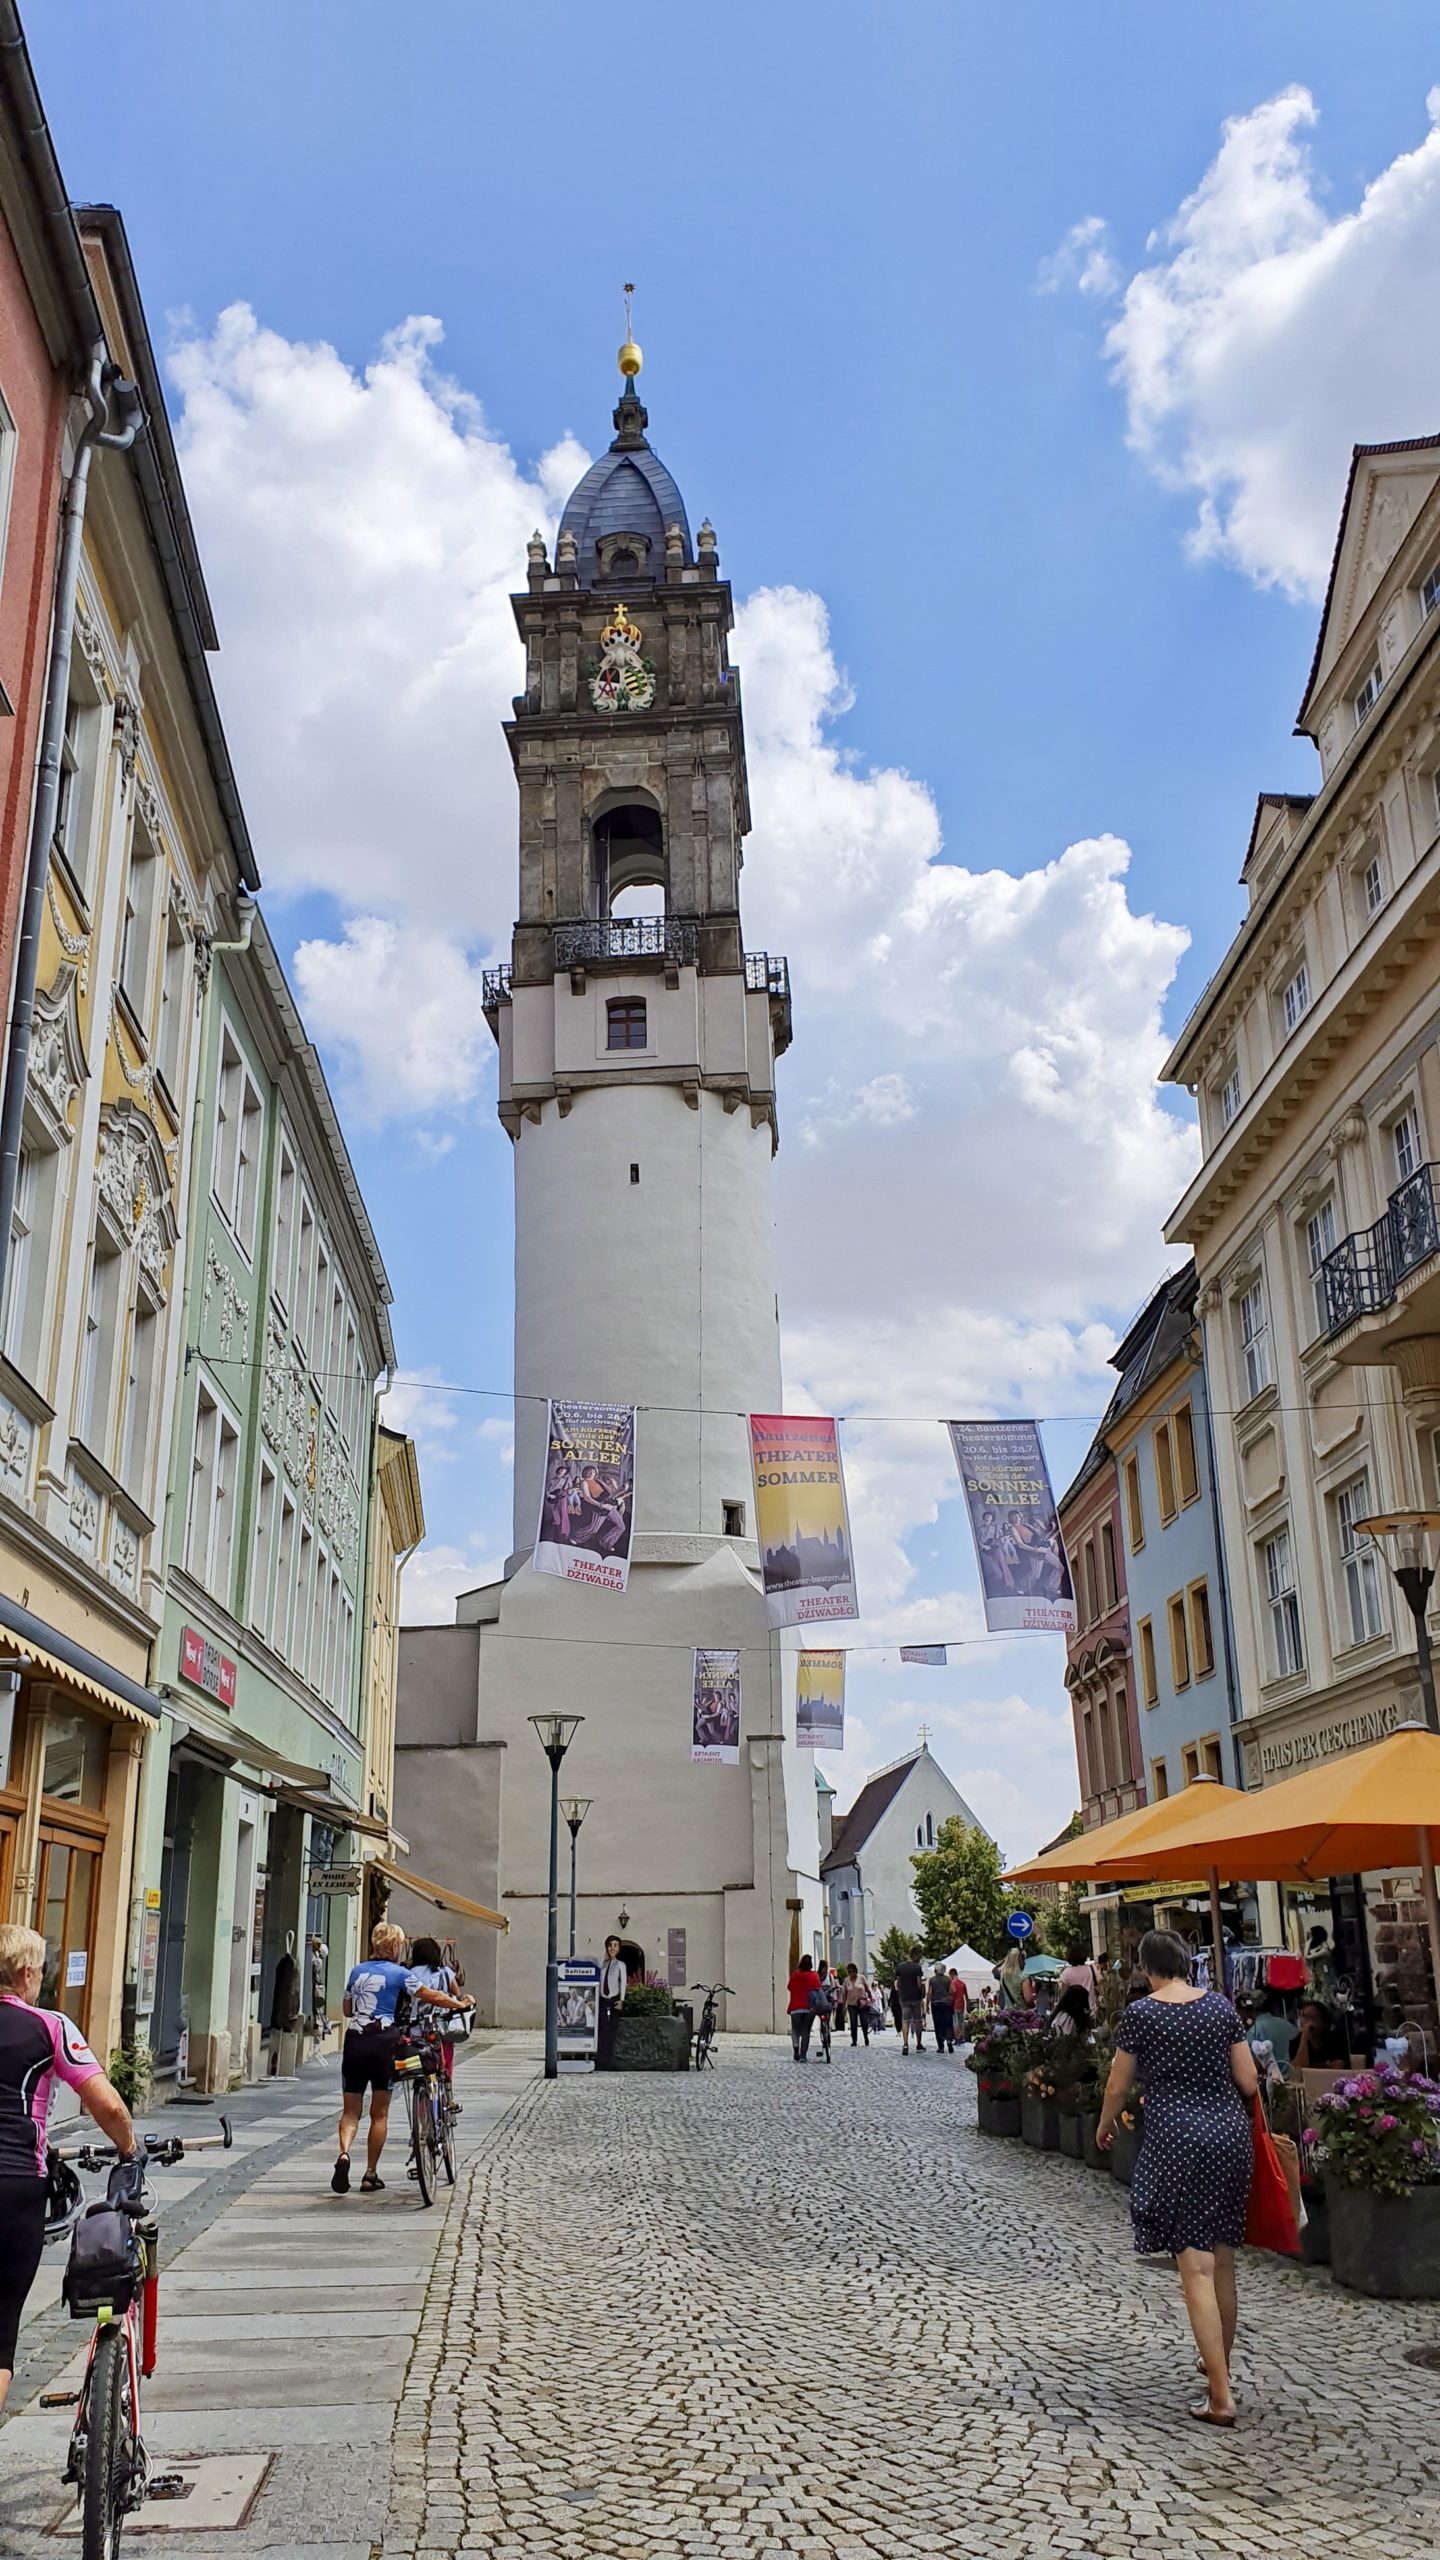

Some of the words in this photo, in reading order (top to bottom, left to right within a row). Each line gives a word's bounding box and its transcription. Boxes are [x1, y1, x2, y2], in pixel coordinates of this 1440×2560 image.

[977, 1424, 1030, 1432] Bautzener
[755, 1431, 833, 1443] Bautzener
[954, 1433, 1038, 1441] Theatersommer
[992, 1445, 1008, 1453] bis
[563, 1450, 621, 1465] ALLEE
[756, 1450, 838, 1464] THEATER
[757, 1472, 840, 1488] SOMMER
[967, 1480, 1050, 1492] SONNEN-
[985, 1493, 1041, 1505] ALLEE
[573, 1559, 622, 1578] THEATER
[566, 1569, 624, 1590] DZIWADŁO
[766, 1573, 850, 1591] www.theater-bautzen.de
[800, 1595, 850, 1607] THEATER
[797, 1607, 854, 1620] DZIWADŁO
[1025, 1608, 1073, 1619] THEATER
[1023, 1620, 1076, 1631] DZIWADŁO
[1261, 1740, 1293, 1773] HAUS
[1294, 1731, 1320, 1764] DER
[1319, 1703, 1400, 1757] GESCHENKE
